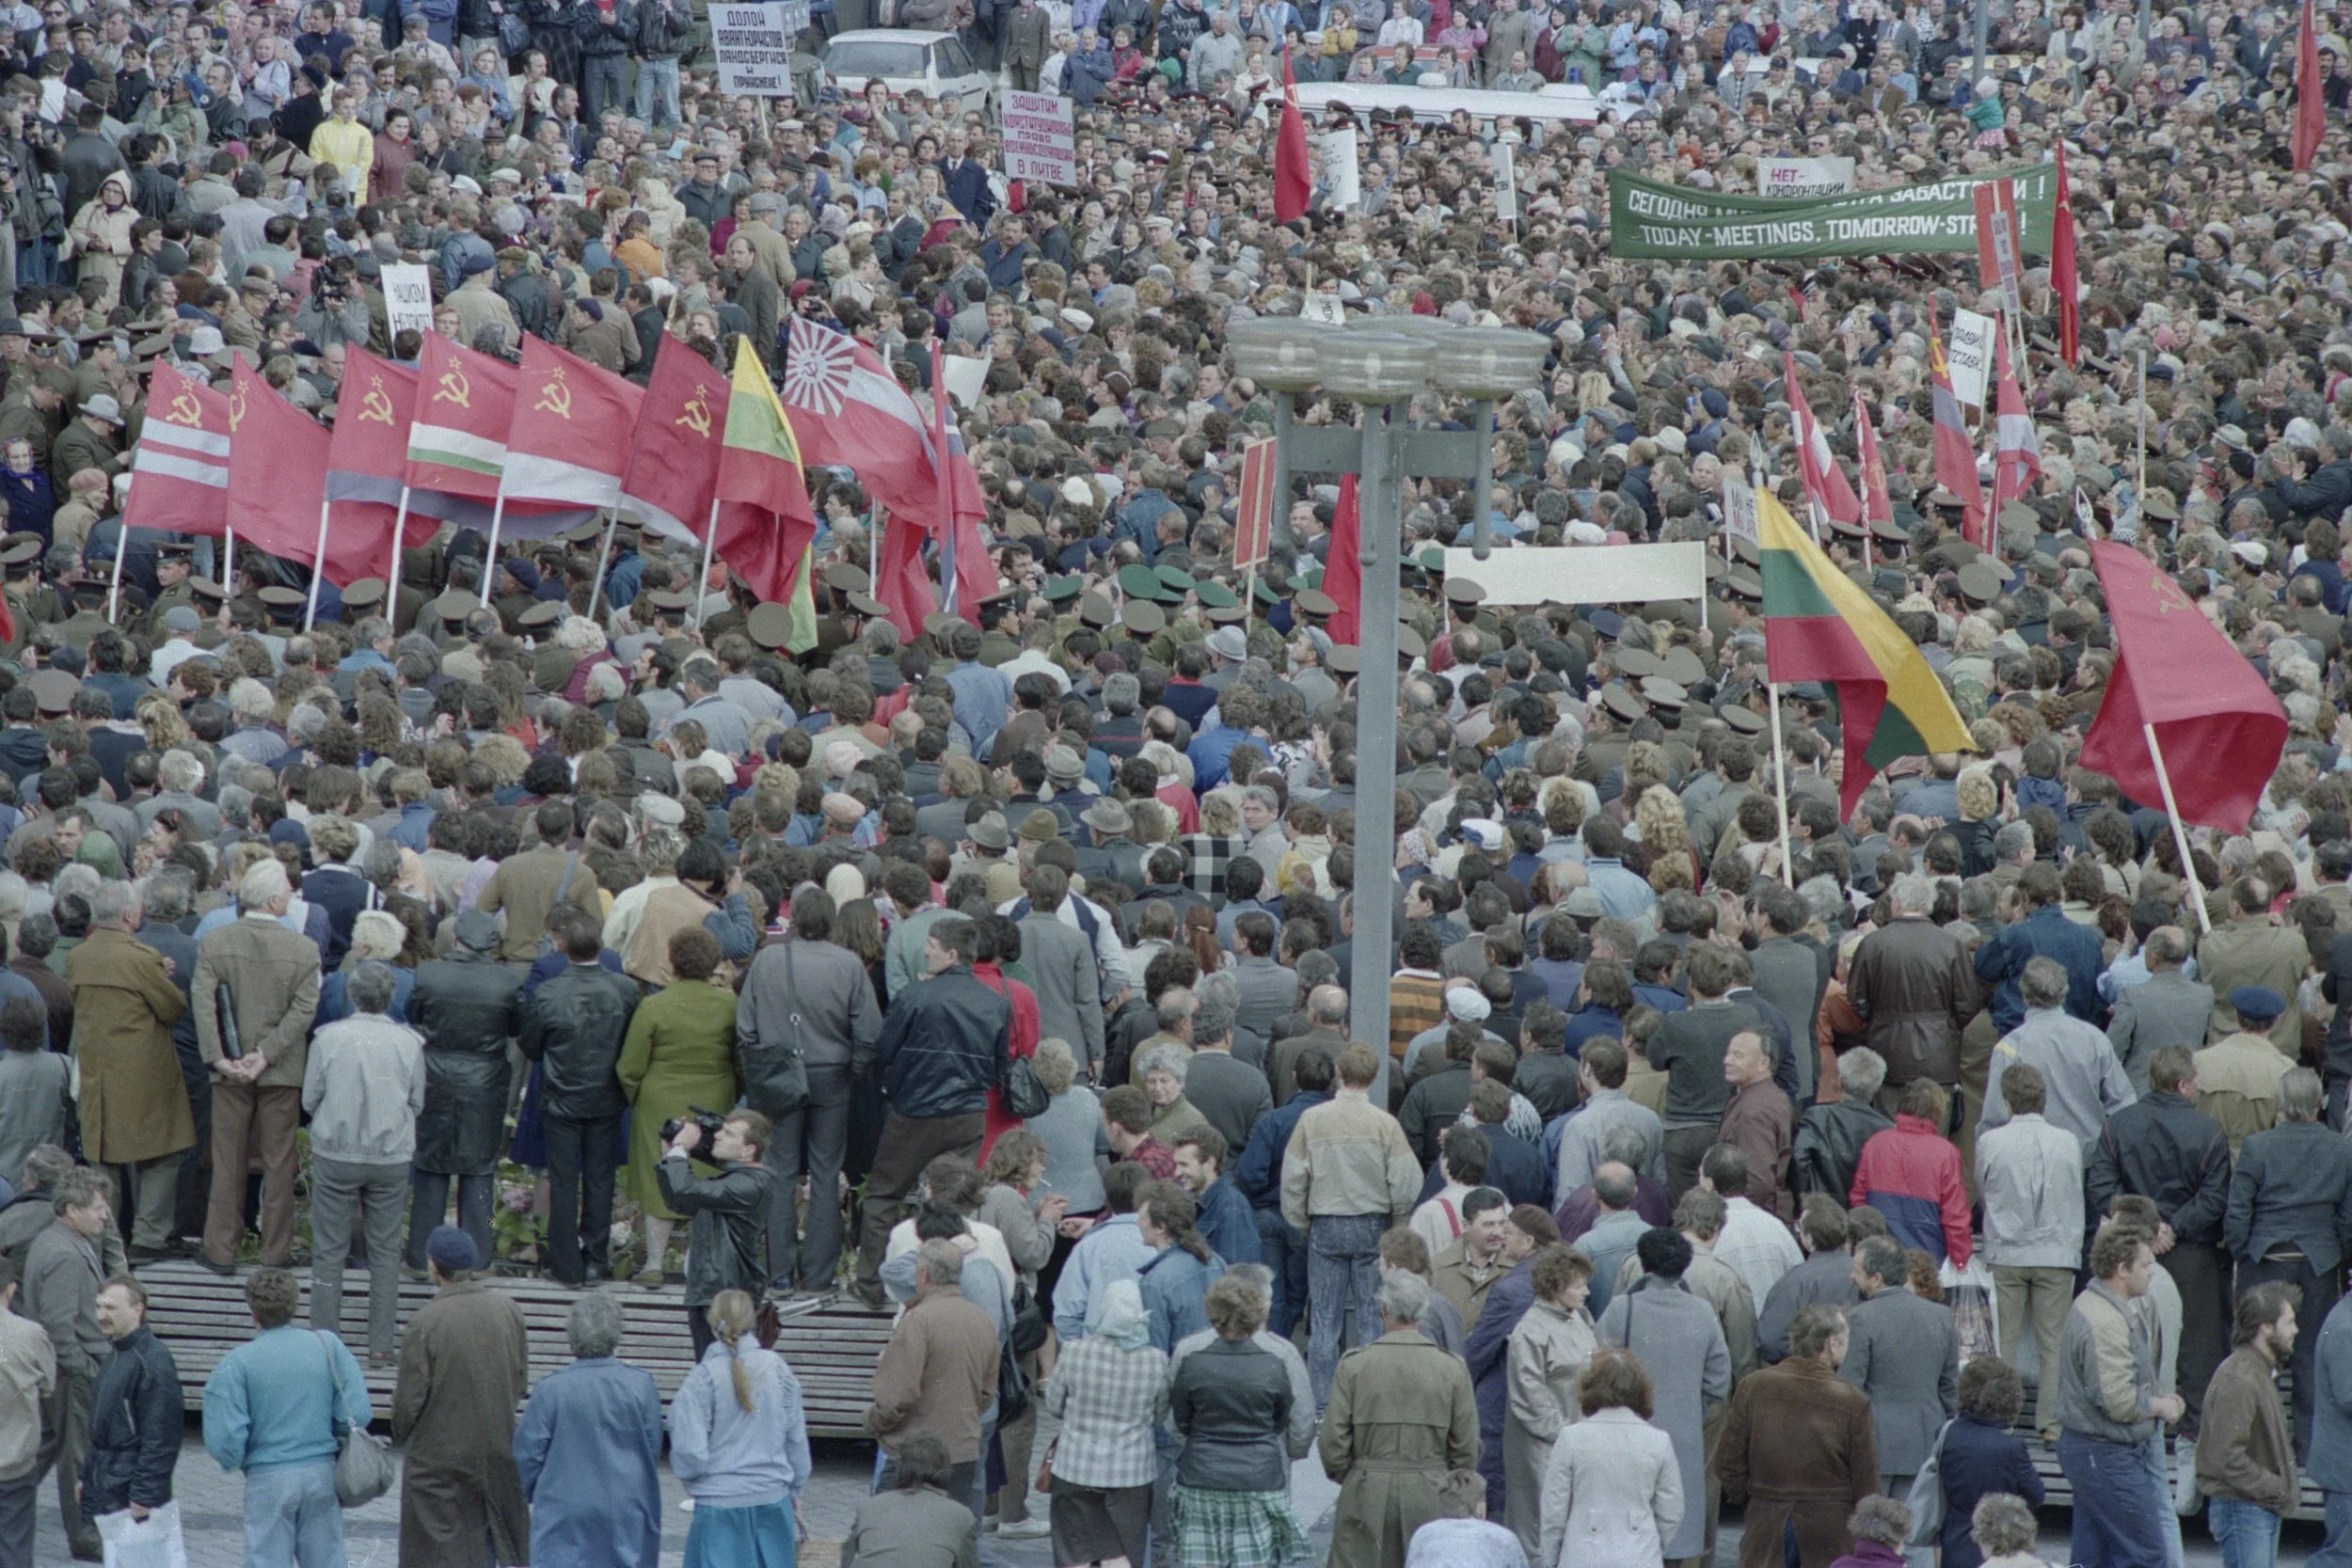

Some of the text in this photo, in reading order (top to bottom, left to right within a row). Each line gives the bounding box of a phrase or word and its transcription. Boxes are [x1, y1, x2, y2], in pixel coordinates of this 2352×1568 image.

[727, 9, 766, 26] ДОЛОЙ
[718, 29, 783, 48] АВАНТЮРИСТОВ
[746, 66, 754, 74] И
[1018, 131, 1051, 143] ПРАВА
[1017, 158, 1064, 181] В ЛИТВЕ
